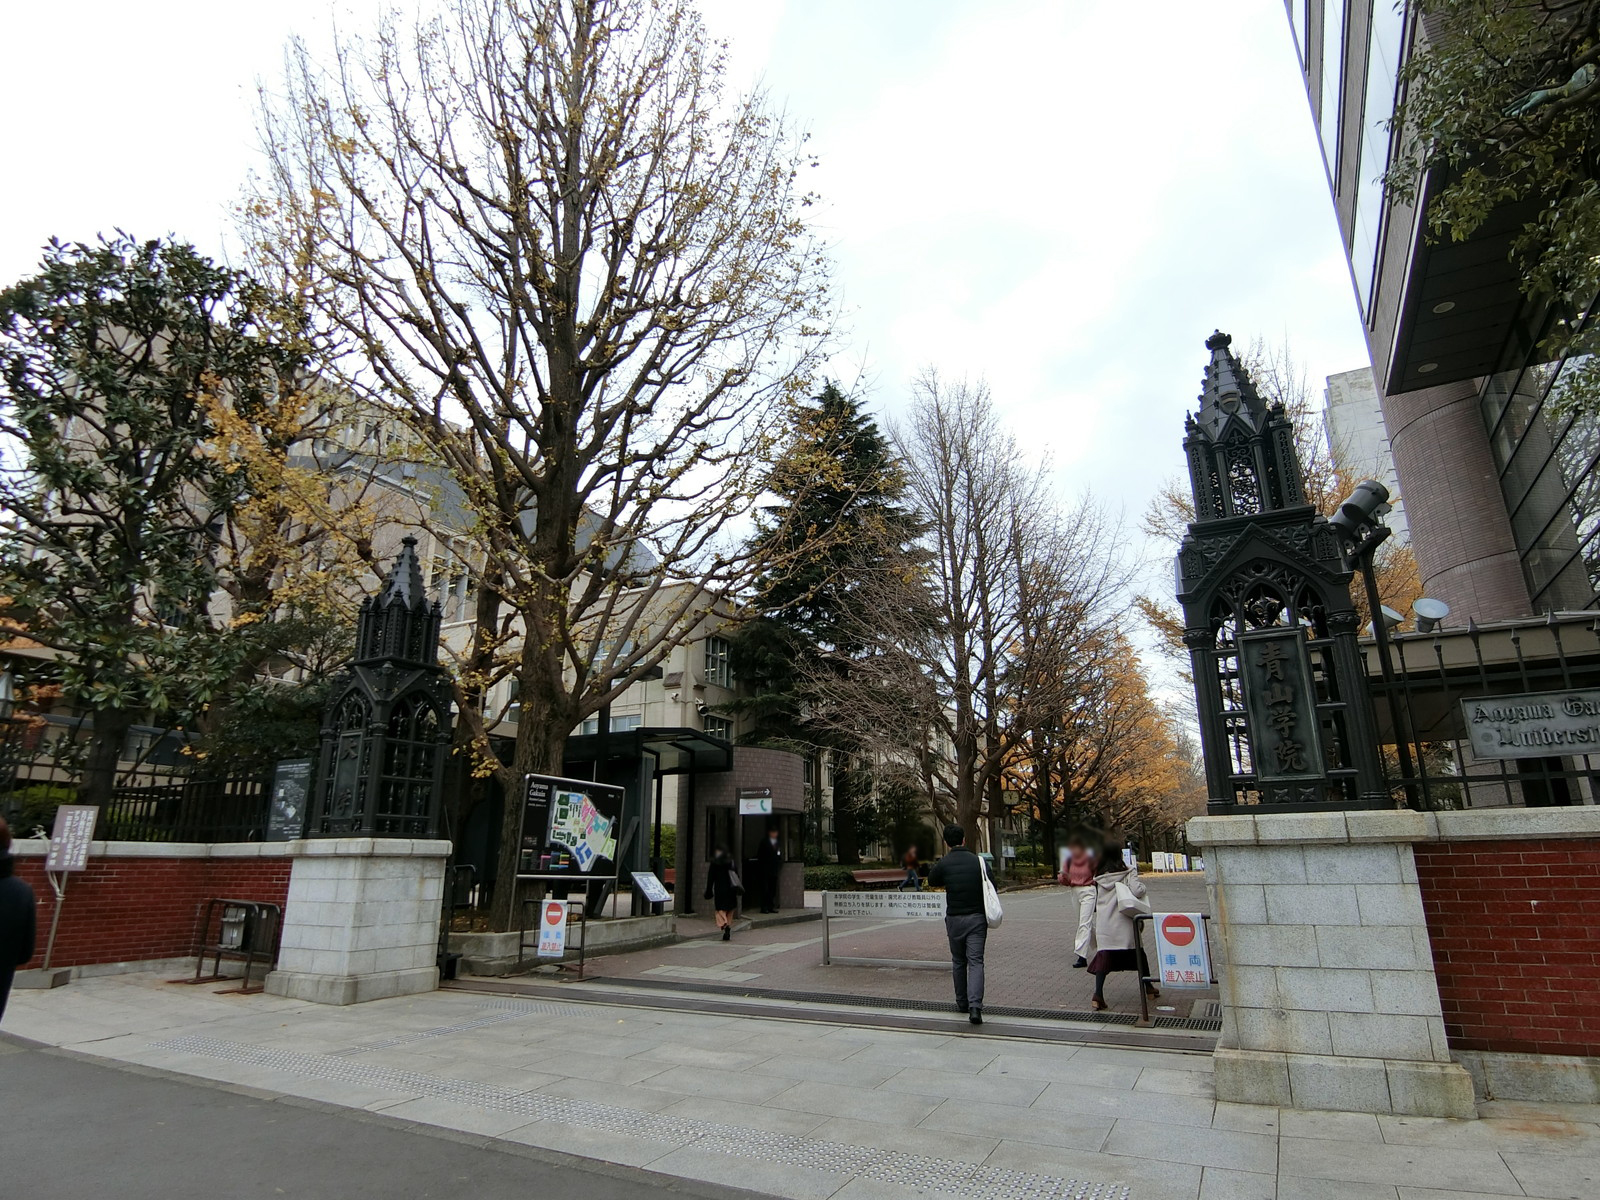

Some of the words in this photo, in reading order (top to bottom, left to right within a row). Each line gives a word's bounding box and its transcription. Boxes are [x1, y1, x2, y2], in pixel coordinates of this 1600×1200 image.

[1257, 642, 1308, 773] 青山学院
[1473, 703, 1555, 724] Aoyama
[1562, 696, 1600, 717] Ga
[1165, 970, 1205, 983] 進入禁止
